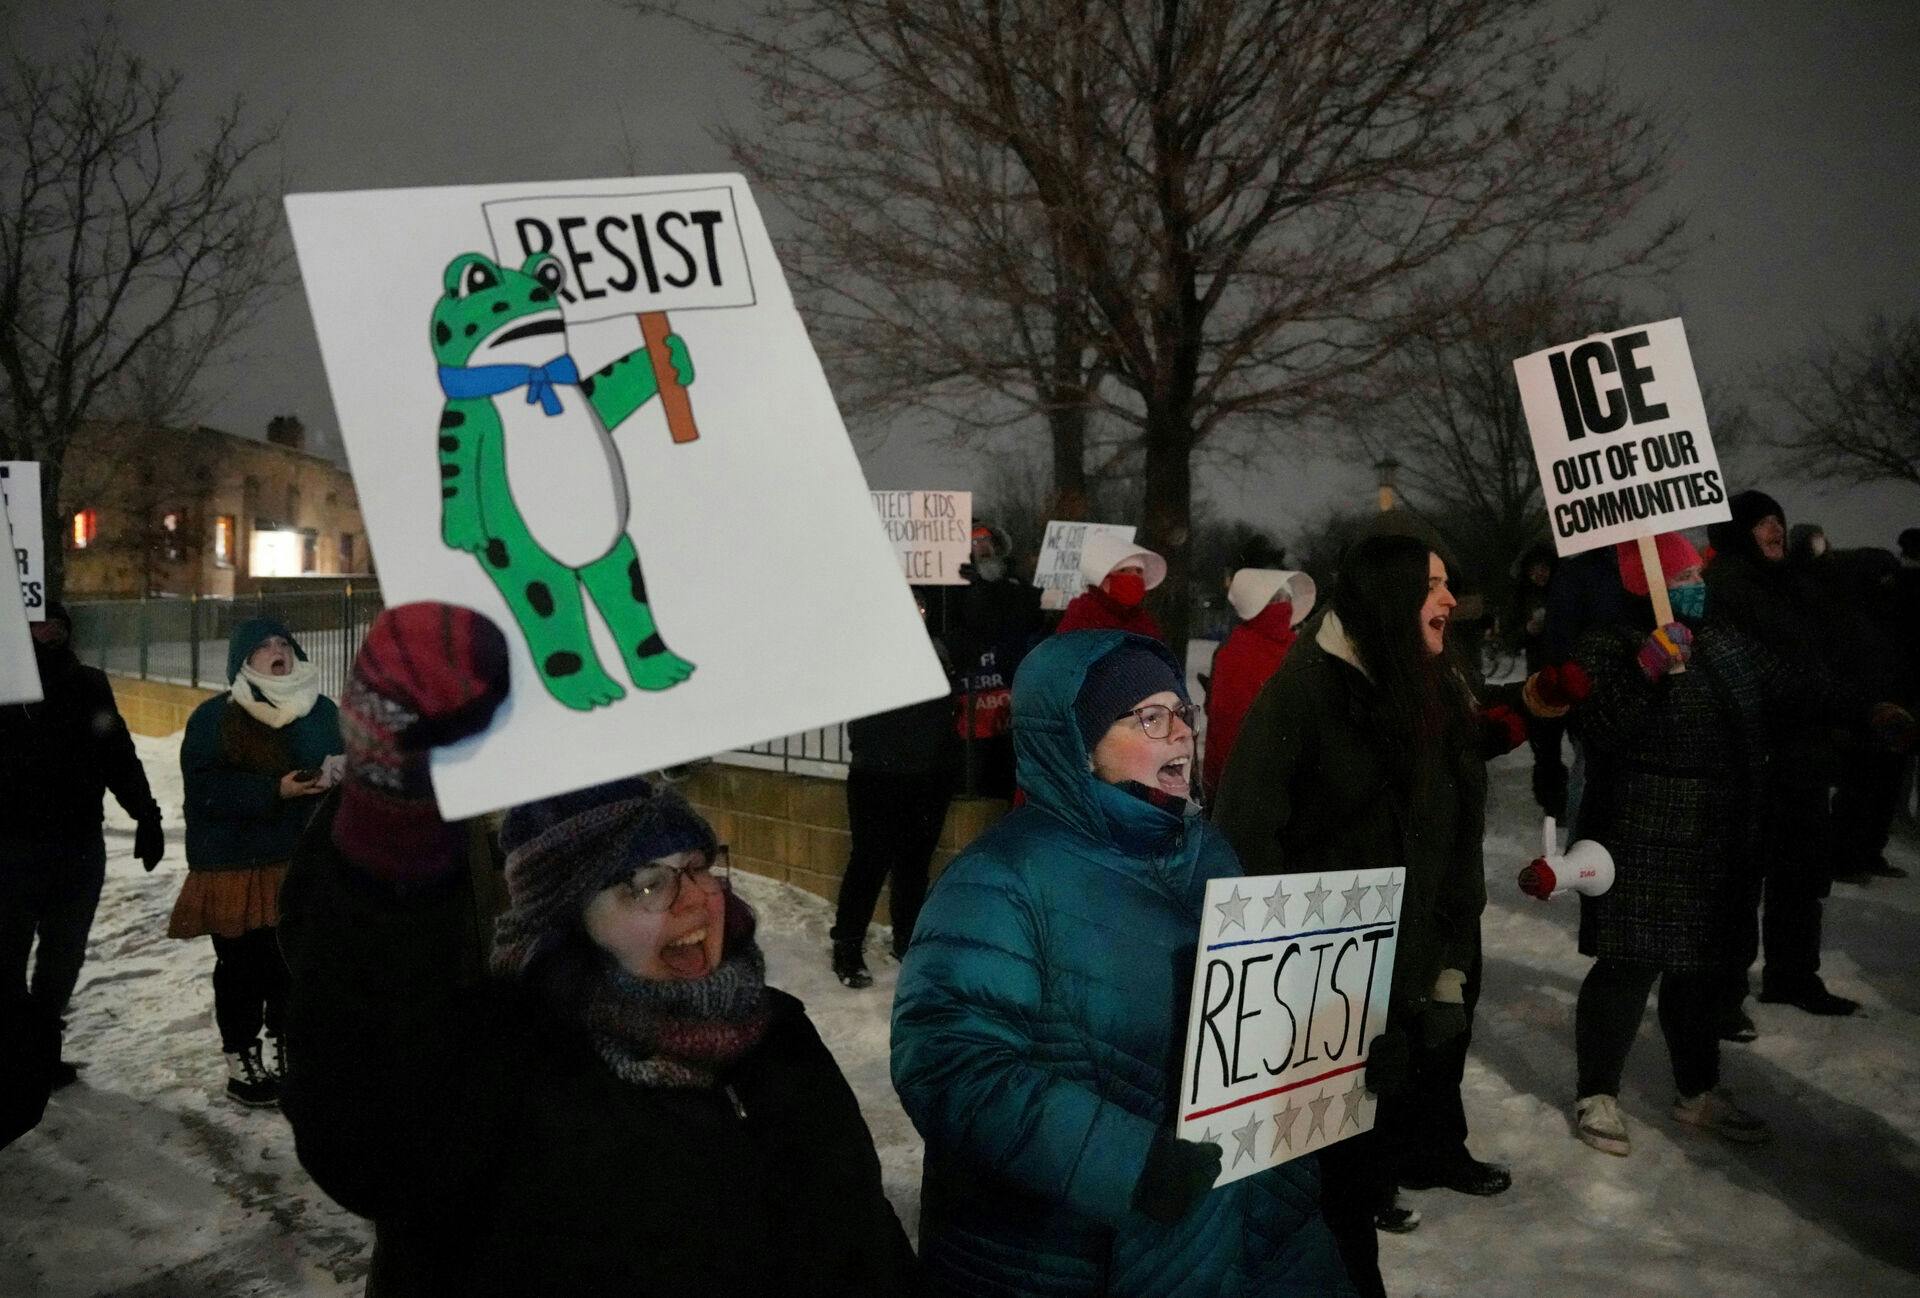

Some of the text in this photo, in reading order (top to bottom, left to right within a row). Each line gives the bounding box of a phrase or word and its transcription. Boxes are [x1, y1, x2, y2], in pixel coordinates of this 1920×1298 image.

[516, 211, 722, 304] RESIST
[1548, 331, 1670, 441] ICE
[1552, 430, 1699, 495] OUT OF OUR
[923, 492, 956, 518] KIDS
[1554, 470, 1724, 538] COMMUNITIES
[1191, 927, 1395, 1105] RESIST
